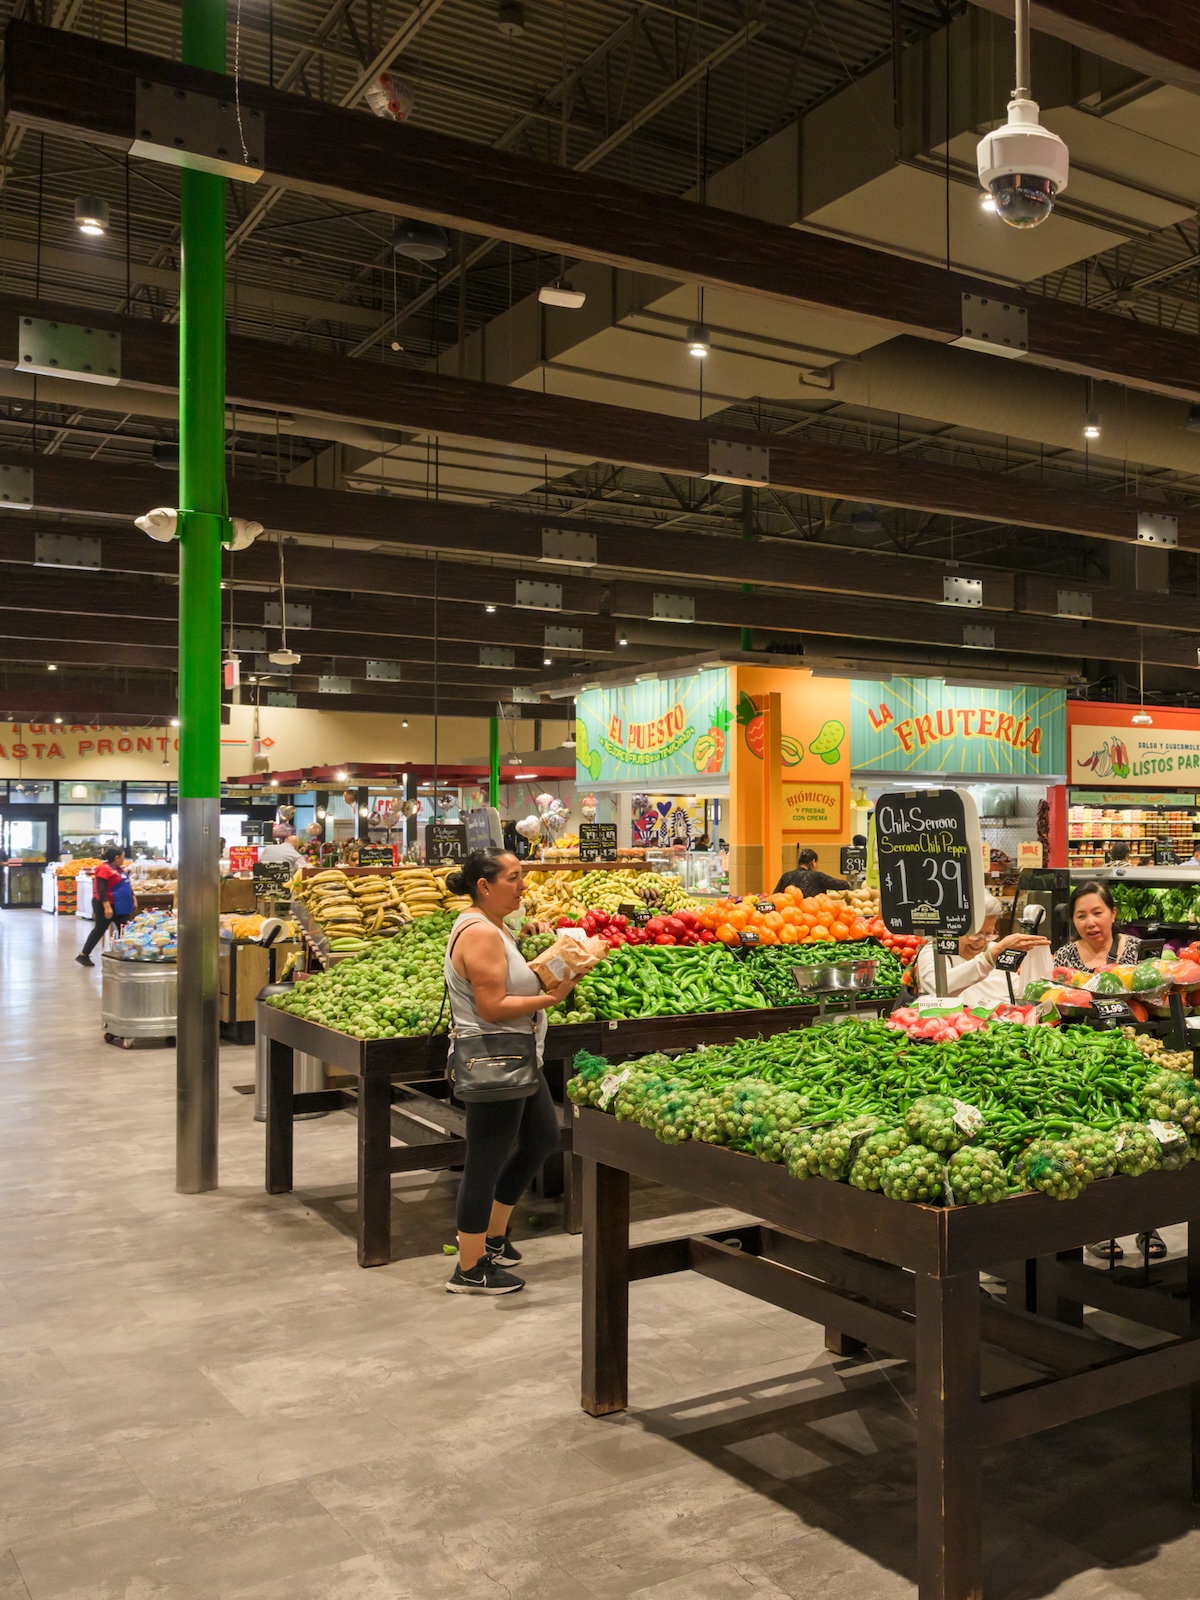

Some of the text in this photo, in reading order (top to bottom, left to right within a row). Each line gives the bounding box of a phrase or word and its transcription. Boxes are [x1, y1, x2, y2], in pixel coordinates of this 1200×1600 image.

[609, 704, 685, 750] EL PUESTO
[868, 703, 1041, 755] LA FRUTERÍA
[1165, 743, 1200, 751] GUACAMOLE
[1132, 757, 1174, 777] LISTOS
[786, 790, 836, 808] BIÓNICOS
[880, 806, 957, 834] Chile Serrano
[880, 836, 920, 854] Serrano
[920, 833, 941, 854] Chili
[1022, 845, 1039, 856] MOLE
